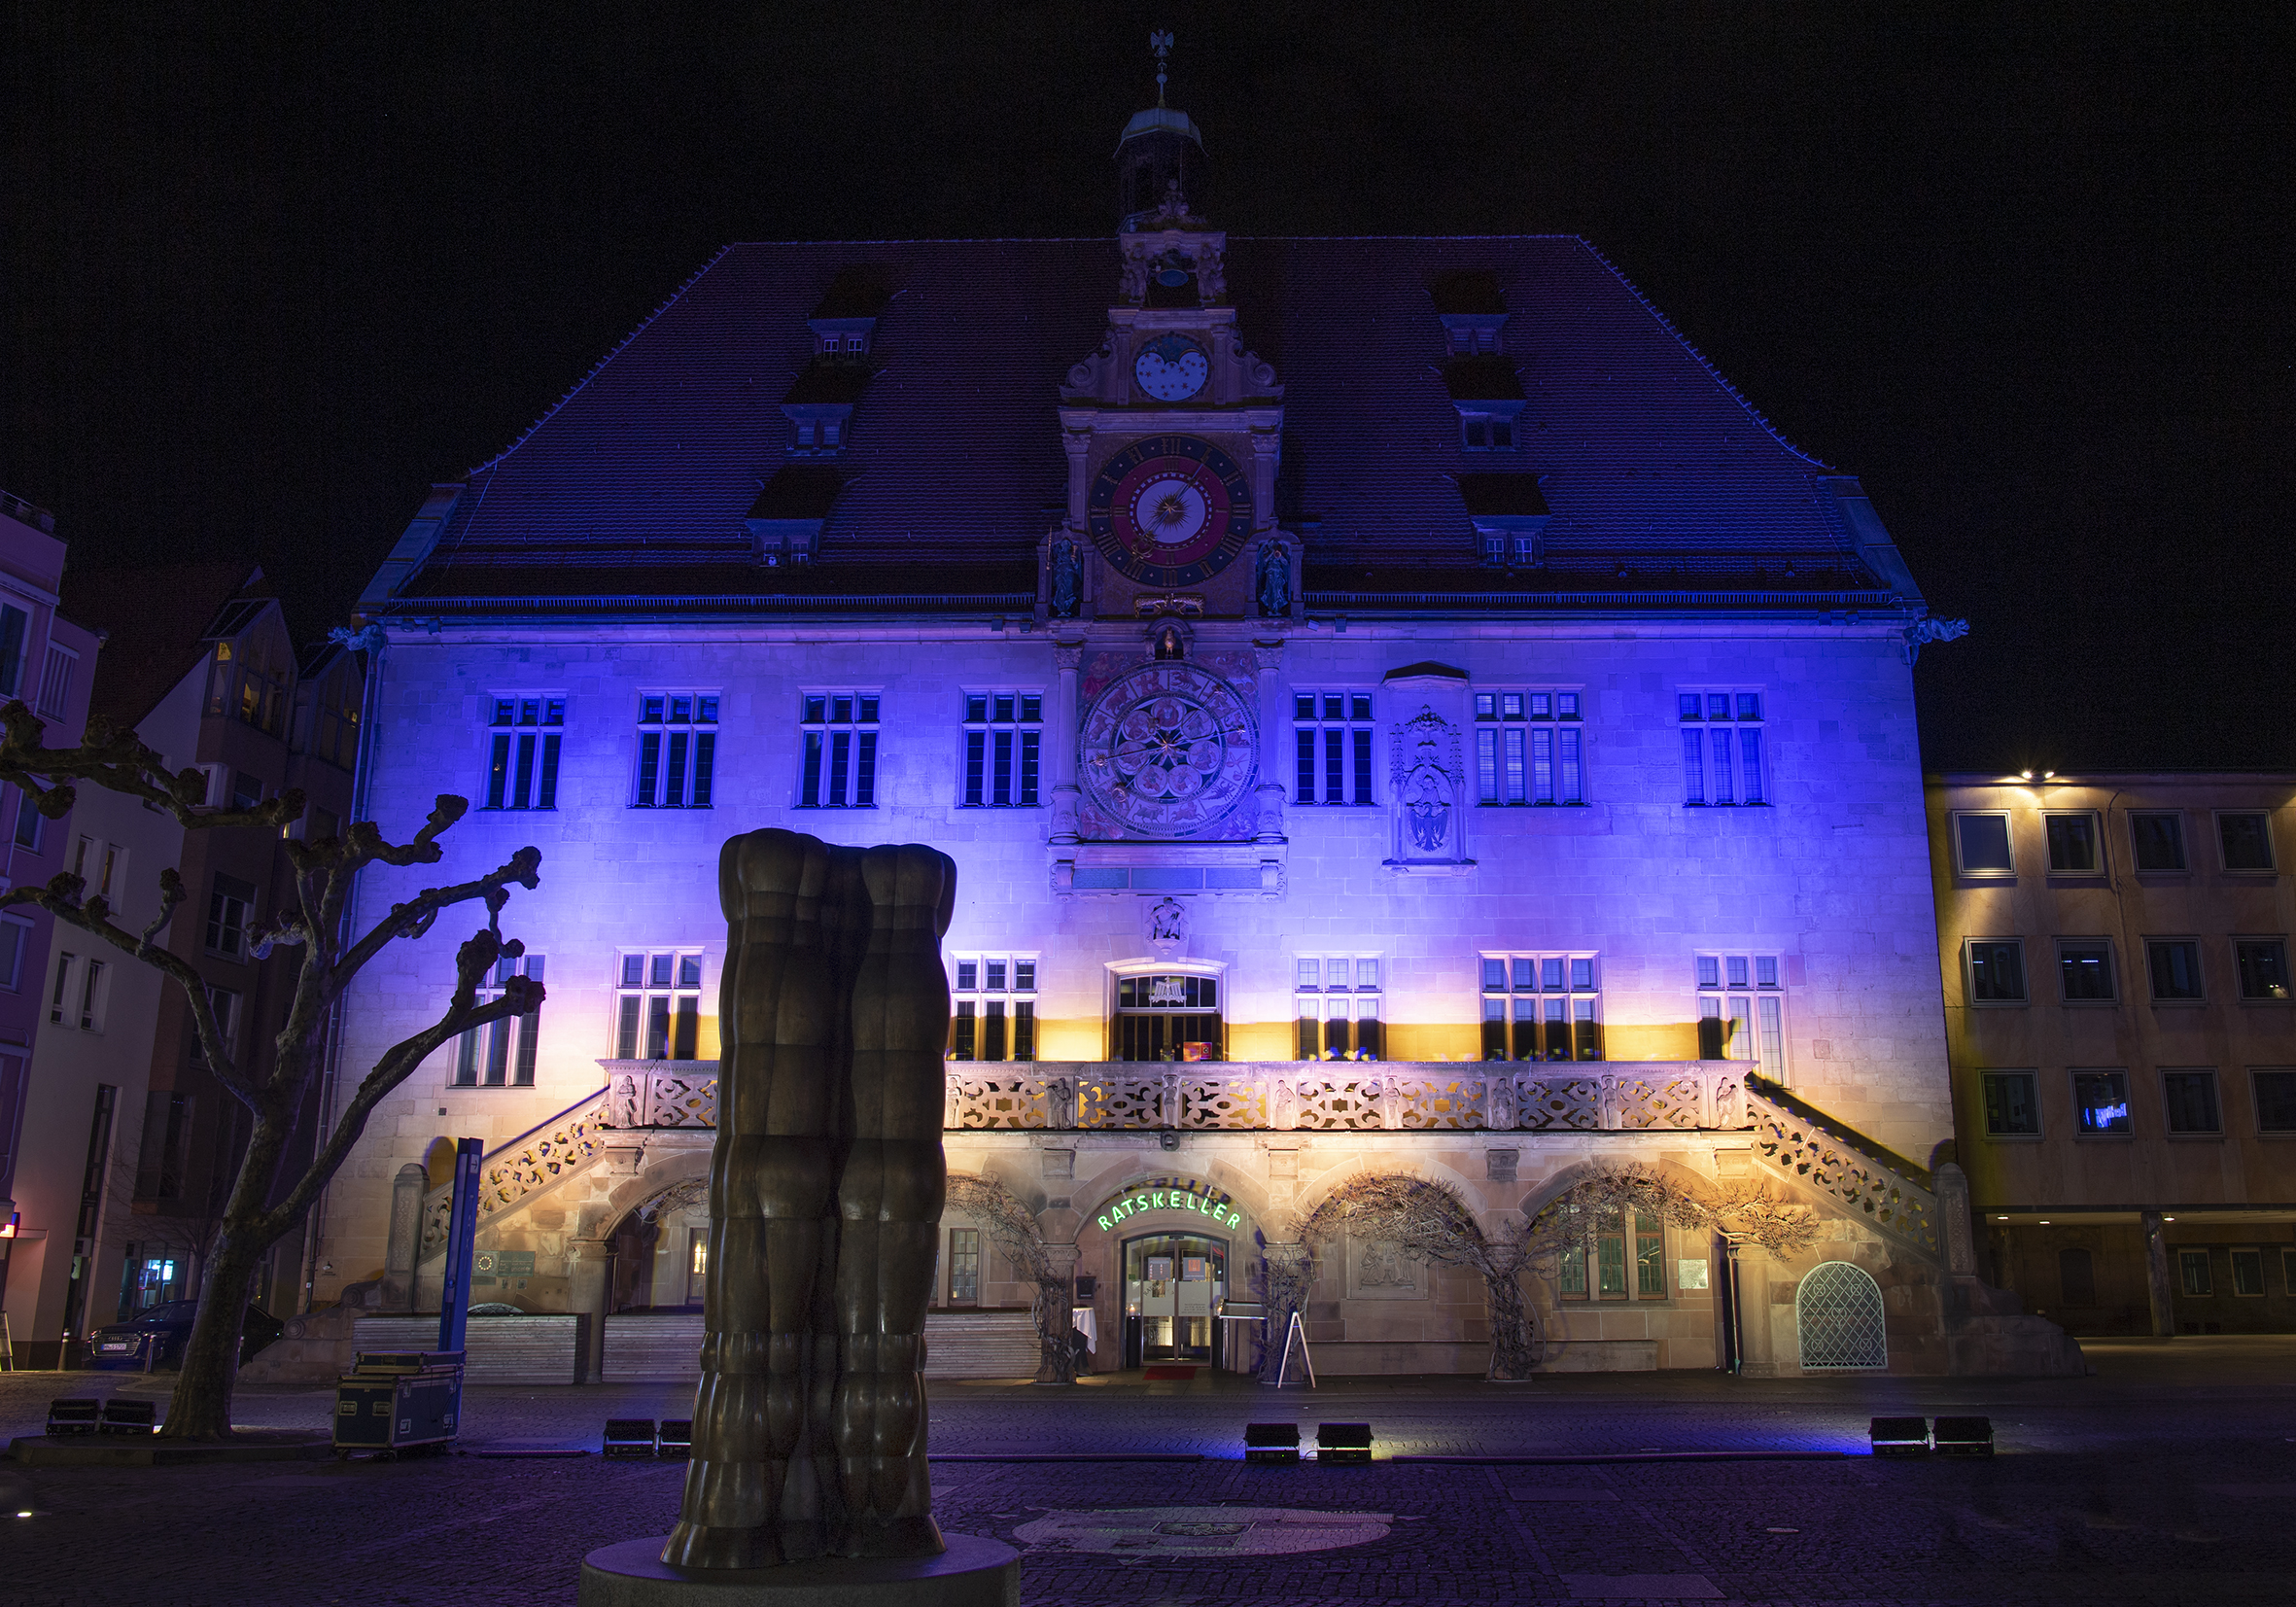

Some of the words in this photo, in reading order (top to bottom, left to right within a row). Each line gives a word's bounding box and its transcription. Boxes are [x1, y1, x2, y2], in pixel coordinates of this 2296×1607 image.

[1162, 437, 1181, 454] XII
[1233, 503, 1251, 519] III
[1097, 1191, 1240, 1231] RATSKELLER
